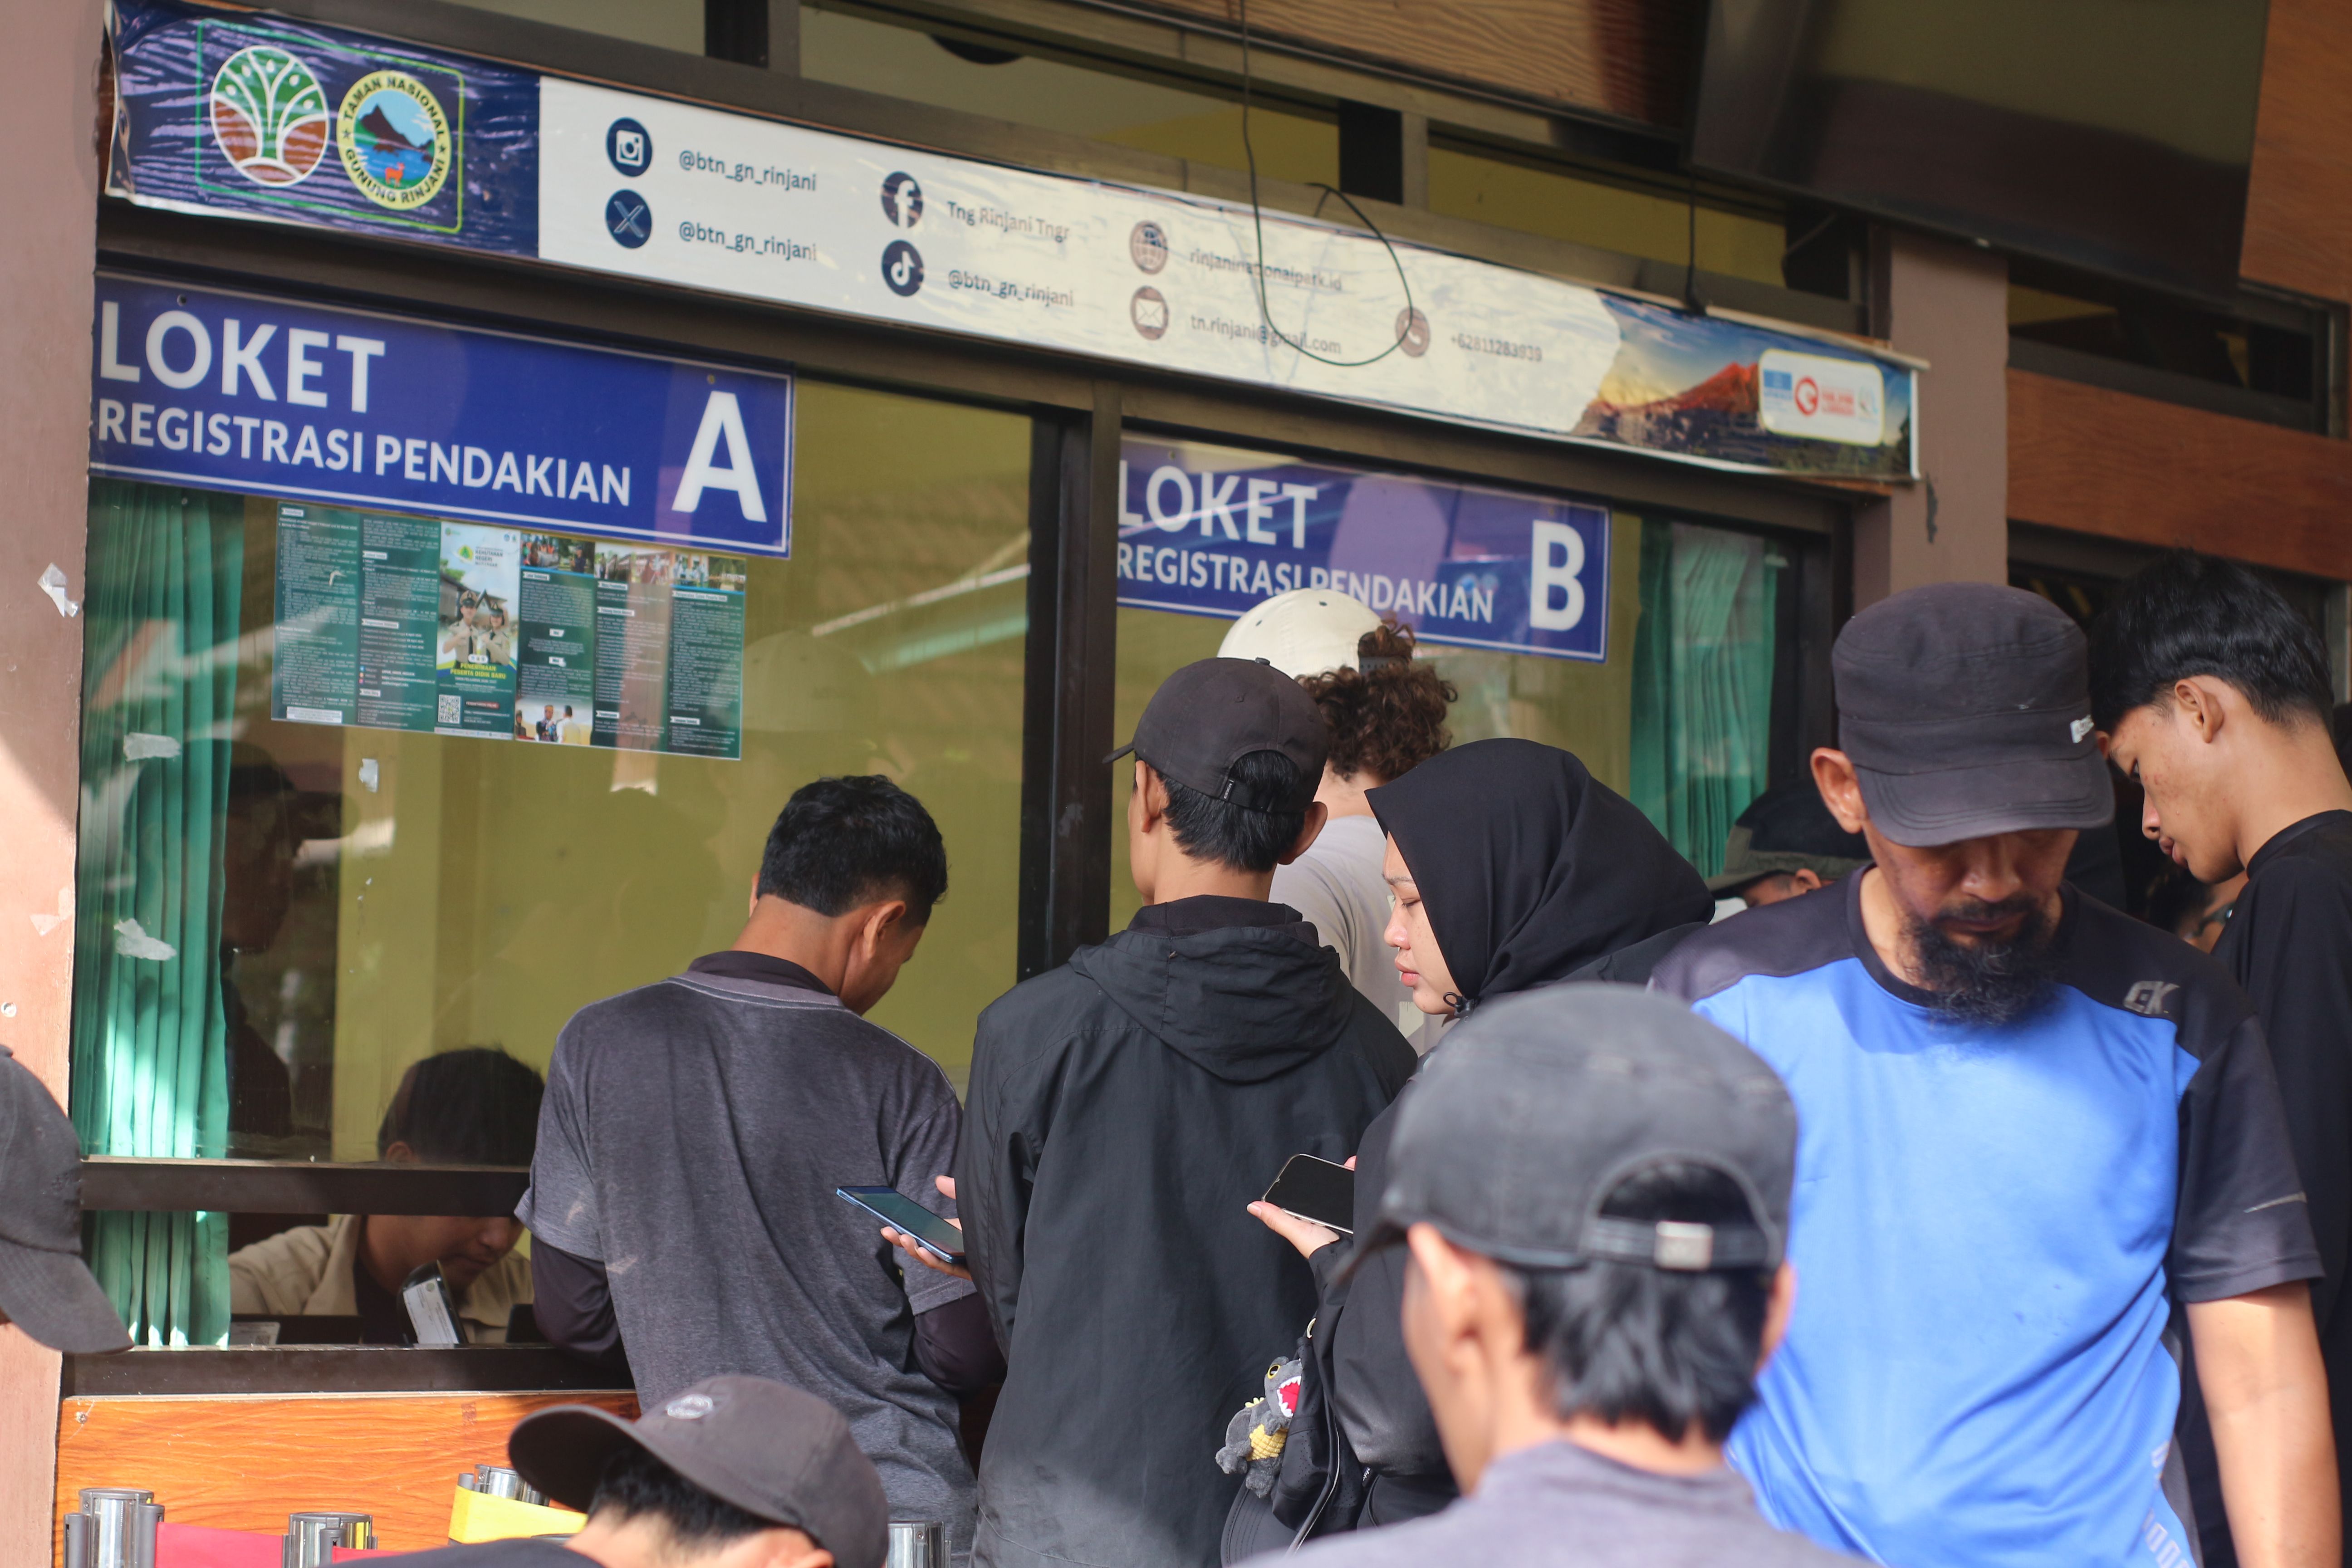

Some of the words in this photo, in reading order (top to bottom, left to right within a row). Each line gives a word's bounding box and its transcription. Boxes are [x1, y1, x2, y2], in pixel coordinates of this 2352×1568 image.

[343, 76, 382, 120] TAMAN
[387, 76, 445, 139] NASIONAL
[345, 147, 396, 202] GUNUNG
[401, 159, 445, 203] RINJANI
[679, 150, 816, 191] @btn_gn_rinjani
[679, 221, 816, 261] @btn_gn_rinjani
[947, 201, 975, 226] Tng
[980, 207, 1032, 232] Rinjani
[1036, 218, 1069, 243] Tngr
[949, 269, 1074, 307] @btn_gn_rinjani
[100, 300, 385, 413] LOKET
[98, 397, 363, 474] REGISTRASI
[376, 434, 631, 507] PENDAKIAN
[671, 390, 767, 523] A
[1118, 460, 1318, 549] LOKET
[1117, 542, 1302, 596] REGISTRASI
[1310, 566, 1493, 624] PENDAKIAN
[1530, 519, 1586, 631] B
